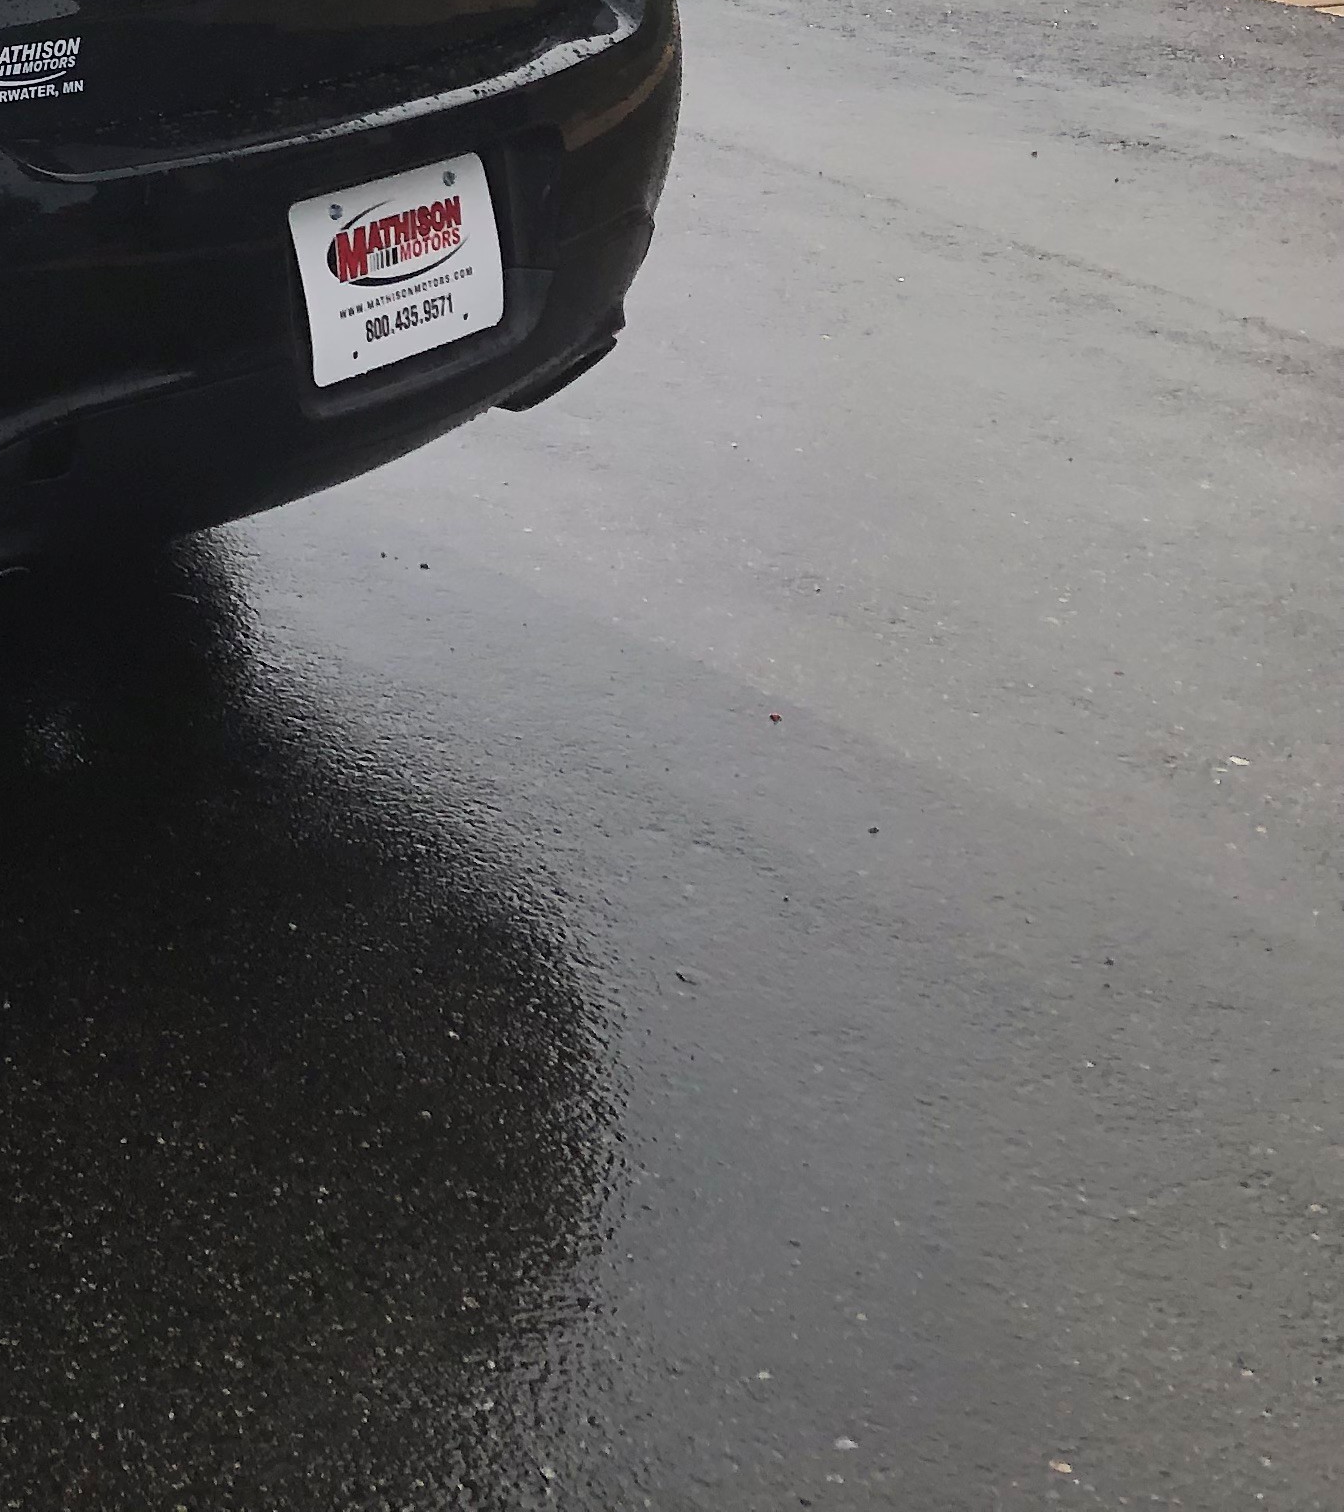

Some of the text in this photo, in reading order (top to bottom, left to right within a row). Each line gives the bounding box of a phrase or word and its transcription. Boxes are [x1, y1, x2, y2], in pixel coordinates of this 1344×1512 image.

[22, 55, 76, 74] MOTORS
[62, 79, 84, 94] MN
[335, 195, 462, 284] MATHISON
[400, 227, 461, 262] MOTORS
[339, 266, 474, 319] WWW.MATHISONMOTORS.COM
[365, 292, 454, 343] 800.435.9571
